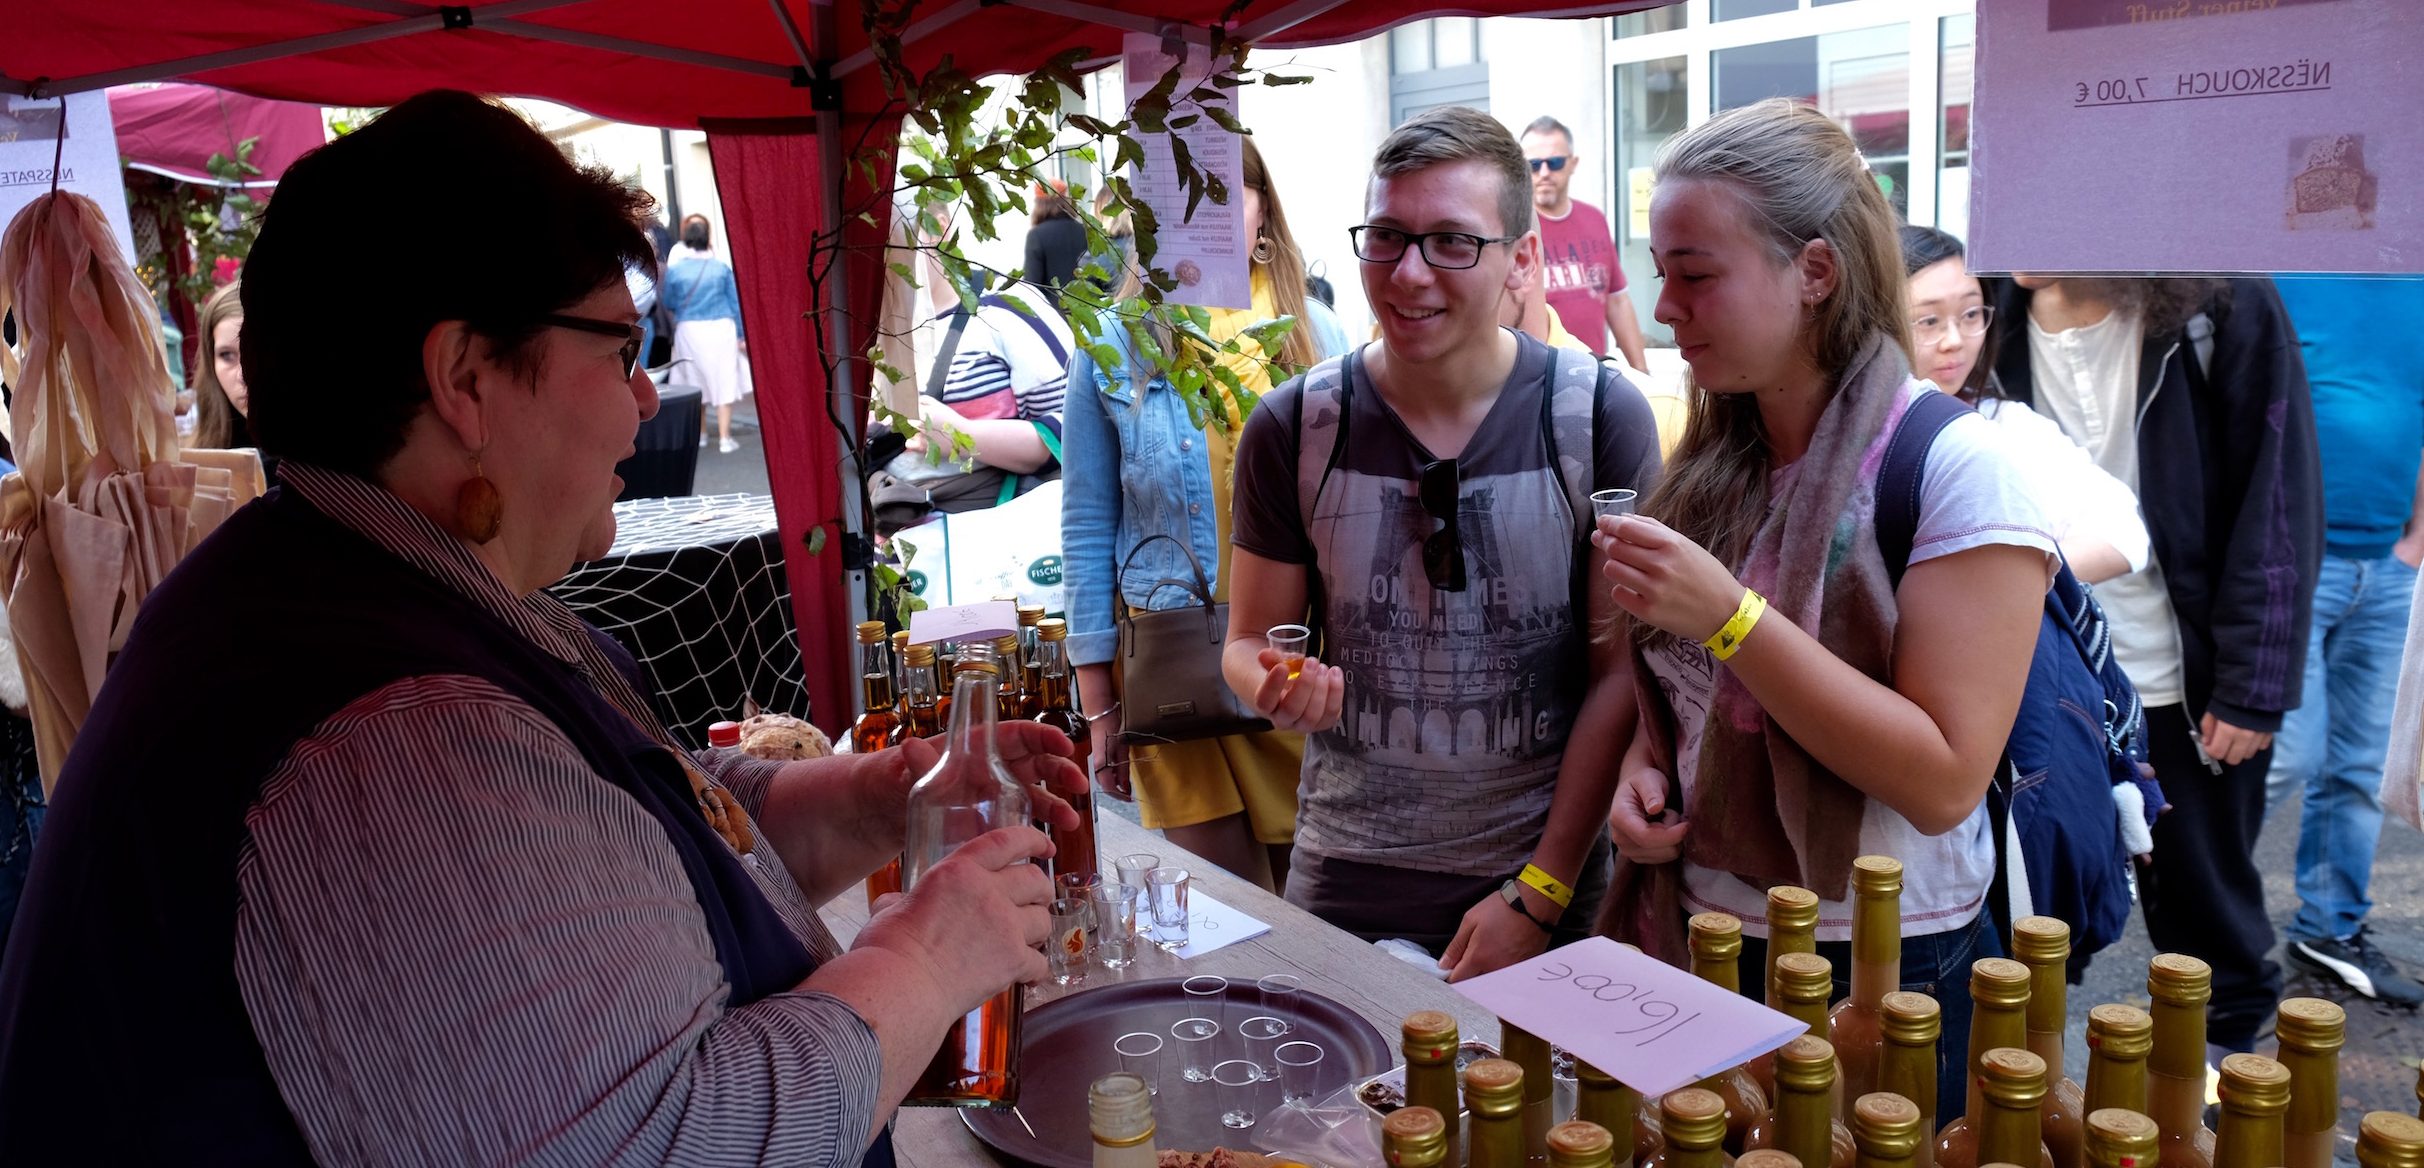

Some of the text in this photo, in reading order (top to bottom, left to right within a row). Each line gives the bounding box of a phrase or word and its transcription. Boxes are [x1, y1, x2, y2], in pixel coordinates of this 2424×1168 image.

[1031, 565, 1063, 578] FISCHE
[1389, 611, 1479, 632] YOU NEED
[1369, 631, 1390, 647] TO
[1409, 698, 1447, 712] THE
